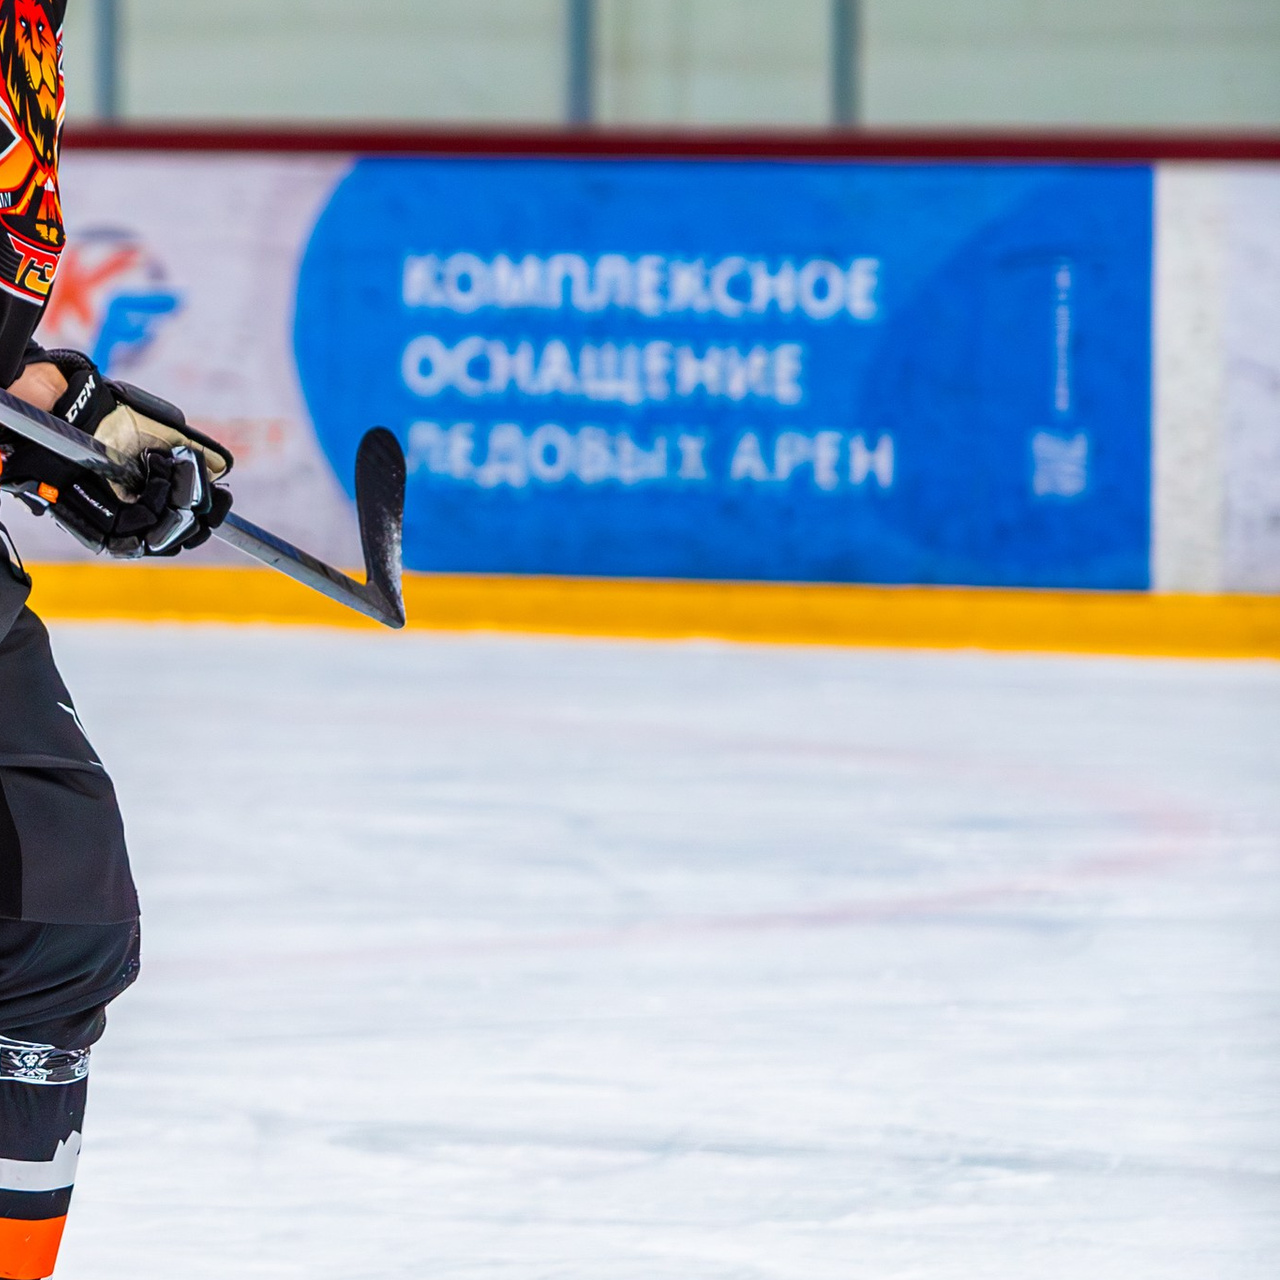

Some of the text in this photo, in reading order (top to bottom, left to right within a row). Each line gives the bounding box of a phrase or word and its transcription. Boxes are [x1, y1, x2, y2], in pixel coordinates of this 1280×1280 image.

[403, 252, 880, 320] КОМПЛЕКСНОЕ
[64, 374, 96, 423] CCM
[402, 335, 803, 405] ОСНАЩЕНИЕ
[730, 431, 894, 490] АРЕН
